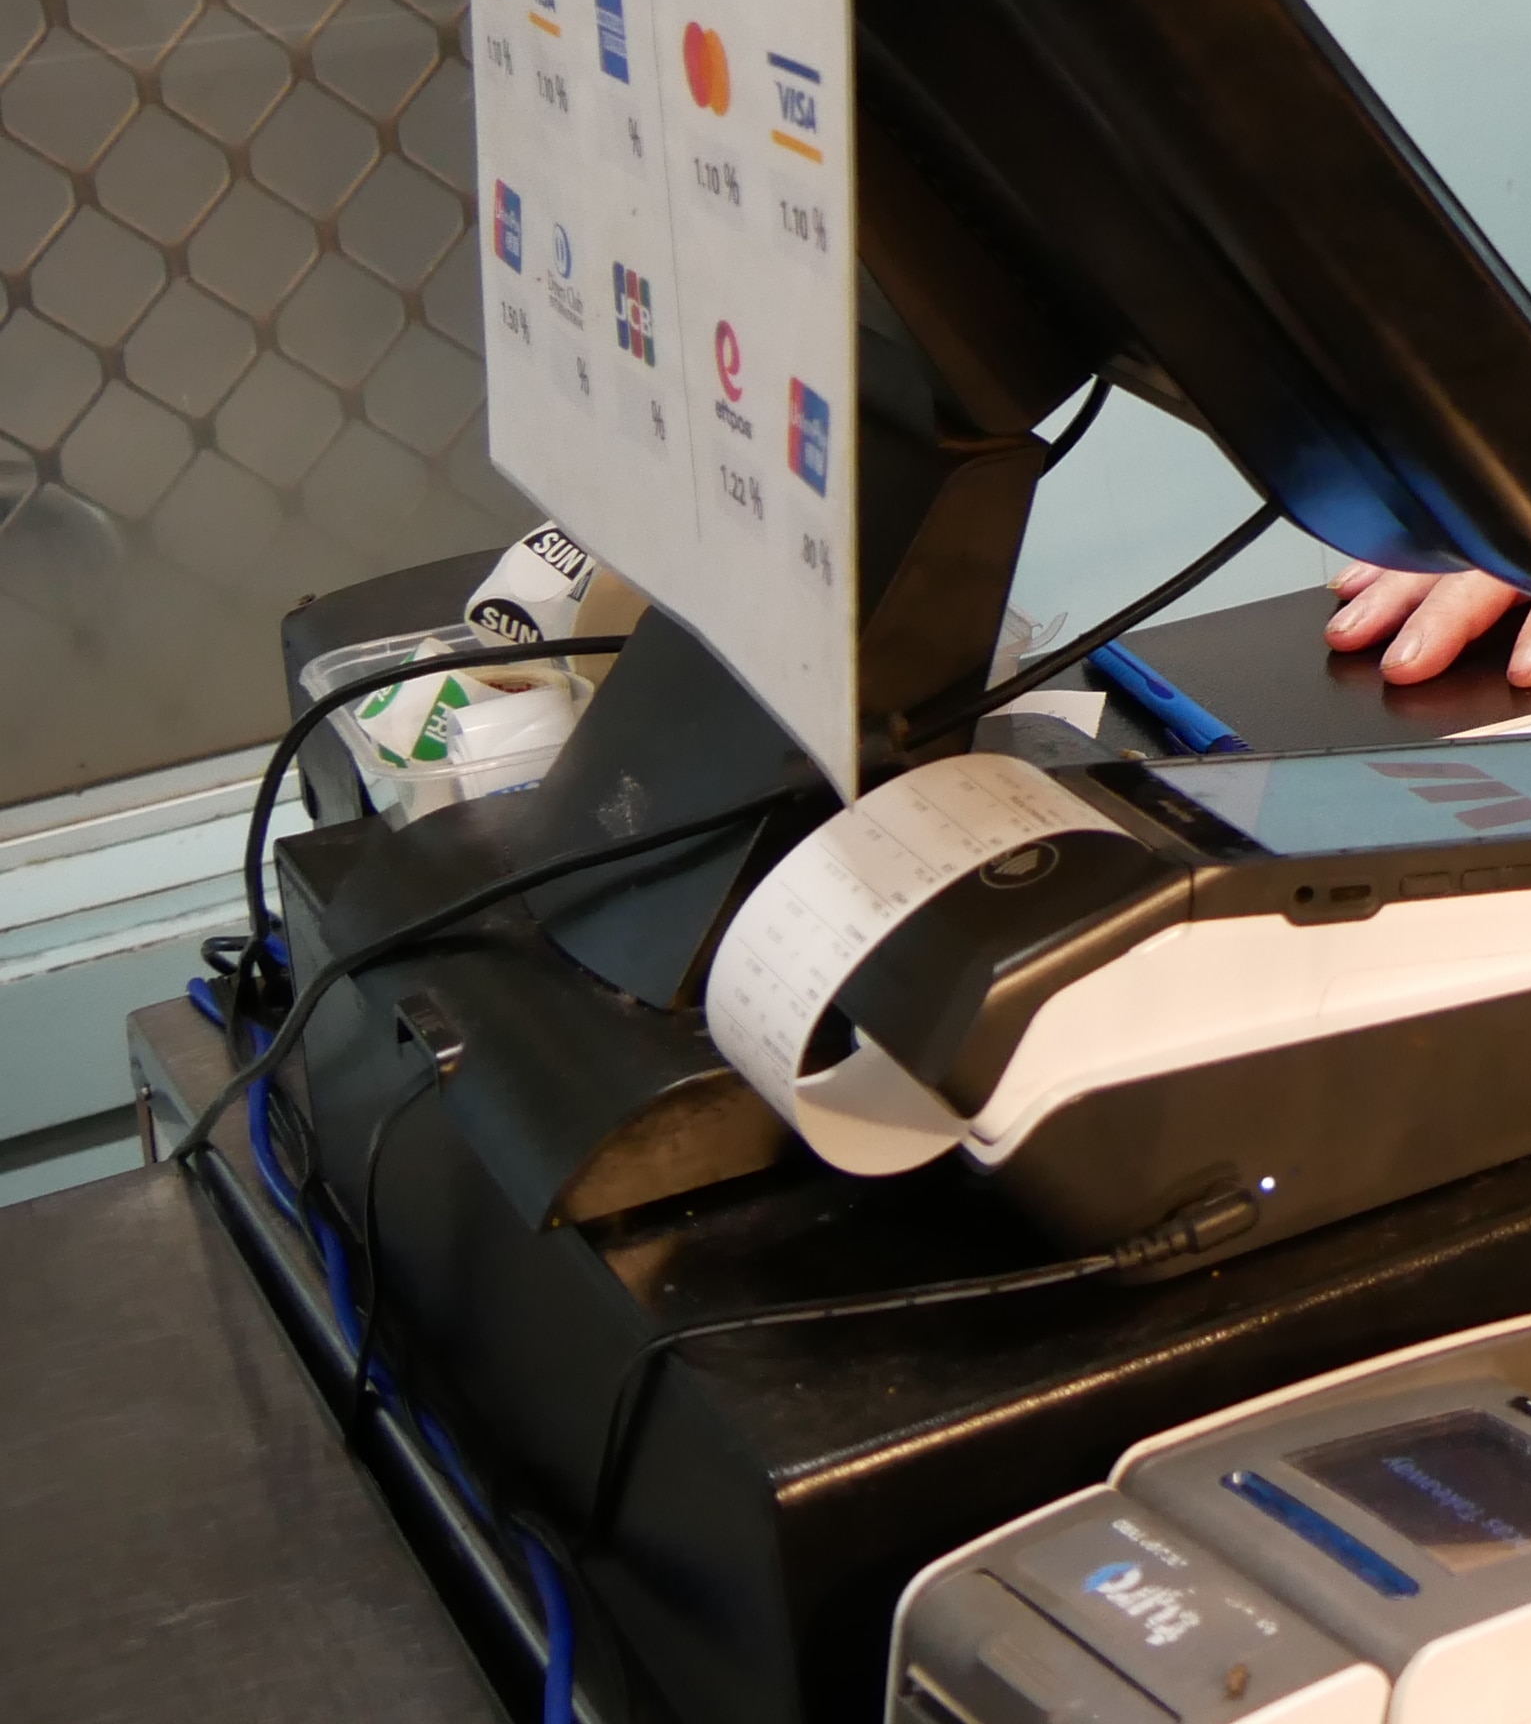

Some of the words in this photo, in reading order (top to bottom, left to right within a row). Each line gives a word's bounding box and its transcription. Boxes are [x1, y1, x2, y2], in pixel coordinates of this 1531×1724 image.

[775, 80, 817, 134] VISA
[694, 157, 720, 196] 1.10
[780, 200, 809, 241] 1.10
[532, 528, 587, 575] SUN
[482, 604, 540, 645] SUN
